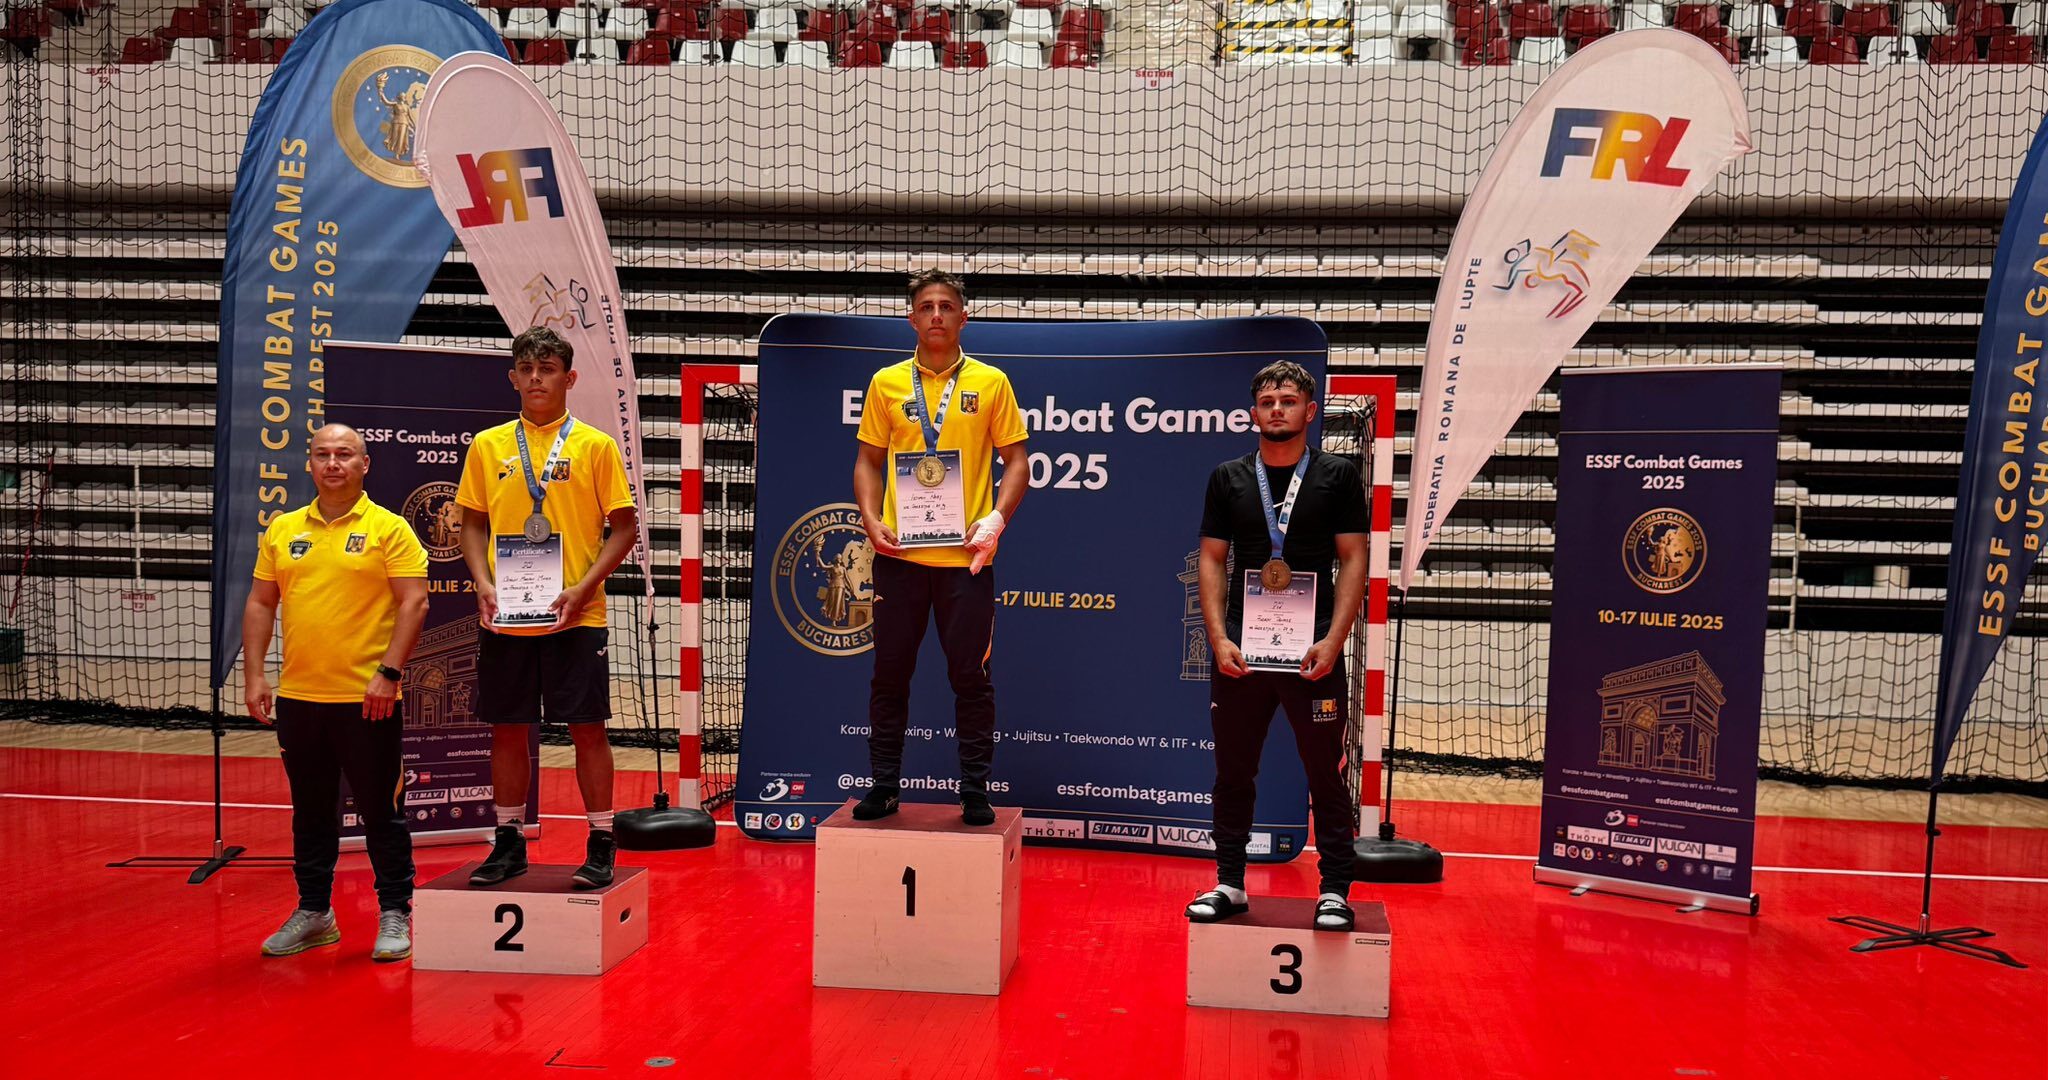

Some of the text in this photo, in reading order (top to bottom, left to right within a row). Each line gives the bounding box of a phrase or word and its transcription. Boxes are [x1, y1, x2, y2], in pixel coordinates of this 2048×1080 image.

[1540, 108, 1691, 187] FRL
[312, 220, 340, 297] 2025
[257, 137, 308, 550] SSF COMBAT GAMES
[1422, 258, 1482, 539] FEDERATIA ROMANA DE LUPTE
[1019, 395, 1261, 434] mbat Game
[396, 429, 458, 445] Combat
[1994, 332, 2043, 523] COMBAT
[416, 450, 459, 464] 2025
[1585, 454, 1743, 469] ESSF Combat Games
[1642, 475, 1685, 490] 2025
[1635, 512, 1666, 532] COMBAT
[1667, 512, 1694, 533] GAMES
[779, 511, 843, 577] ESSF COMBAT
[428, 580, 459, 593] ULIE
[1636, 572, 1685, 590] BUCHAREST
[1978, 537, 2011, 636] ESSF
[1023, 591, 1065, 608] IULIE
[1069, 592, 1116, 610] 2025
[1598, 609, 1724, 631] 10-17 IULIE 2025
[1012, 730, 1052, 744] Jujitsu
[1063, 732, 1134, 746] Taekwondo
[1137, 736, 1157, 747] WT
[1159, 737, 1169, 748] &
[1171, 738, 1189, 749] ITF
[452, 786, 493, 799] VULCAN
[1057, 782, 1213, 805] essfcombatgames
[1092, 823, 1149, 837] SIMAVI
[1614, 834, 1652, 847] SIMAVI
[1659, 840, 1701, 855] VULCAN
[901, 866, 916, 917] 1
[494, 903, 525, 952] 2
[1269, 943, 1303, 995] 3
